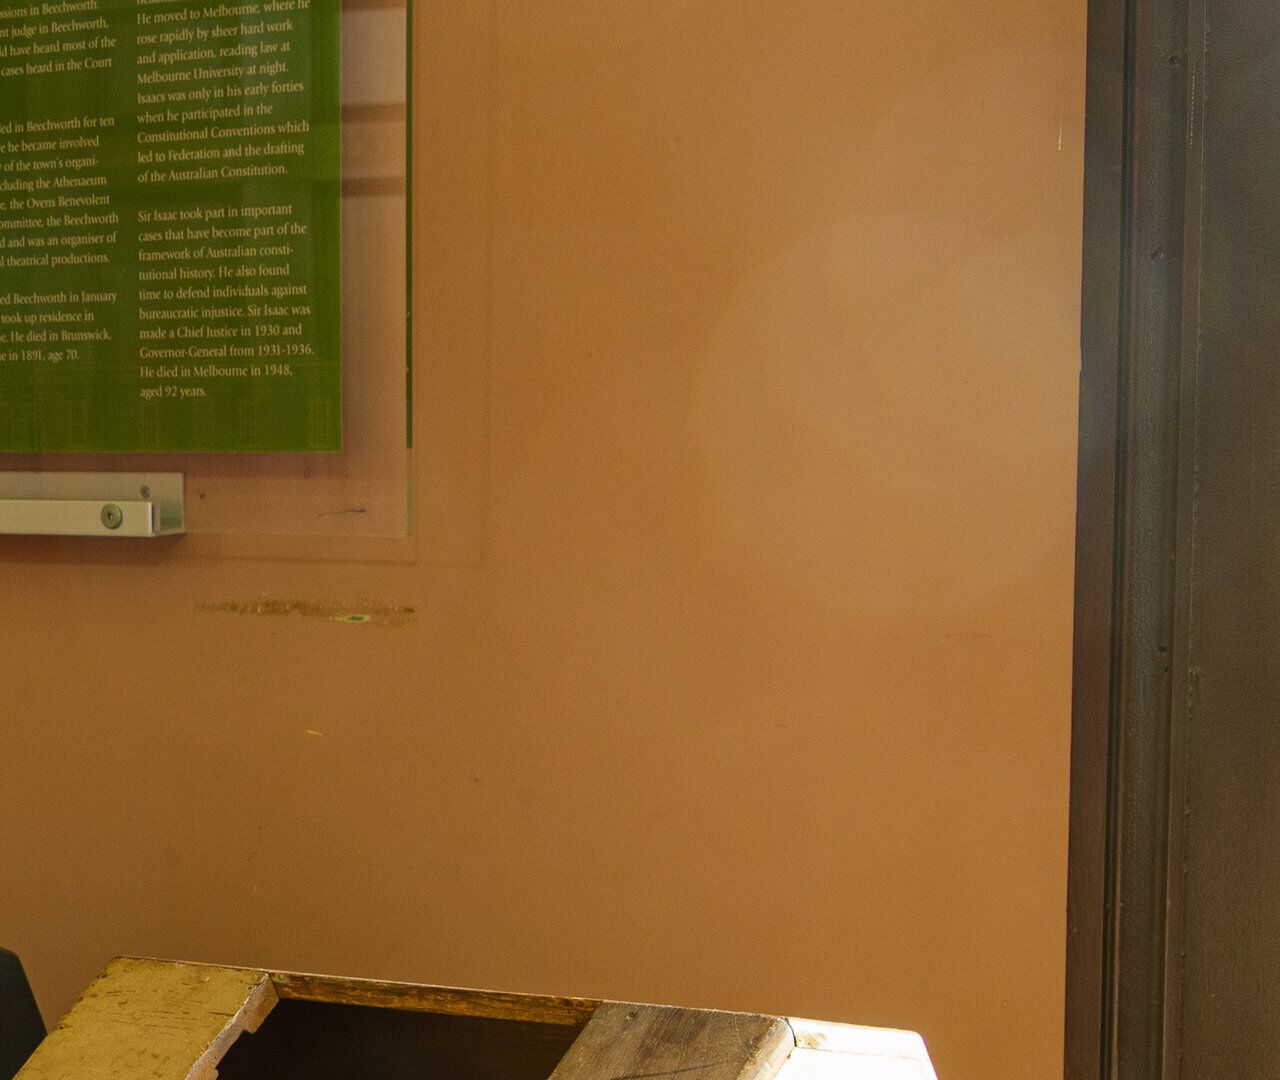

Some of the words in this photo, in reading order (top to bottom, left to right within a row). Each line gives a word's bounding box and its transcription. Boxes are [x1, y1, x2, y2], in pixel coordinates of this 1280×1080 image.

[154, 8, 187, 23] moved
[262, 0, 295, 13] where
[137, 35, 156, 44] rose
[159, 29, 194, 44] rapidly
[211, 25, 237, 38] sheer
[240, 21, 264, 35] hard
[266, 19, 292, 33] work
[137, 70, 190, 84] Melbourne
[193, 66, 244, 81] University
[138, 127, 208, 143] Constitutional
[210, 124, 275, 138] Conventions
[278, 120, 310, 134] which
[150, 170, 166, 182] the
[169, 168, 218, 181] Australian
[9, 198, 24, 210] the
[26, 197, 56, 209] Ovens
[57, 194, 110, 207] Benevolent
[46, 215, 61, 227] the
[63, 212, 118, 226] Beechworth
[138, 210, 150, 222] Sir
[153, 209, 177, 221] Isaac
[180, 207, 202, 220] took
[204, 207, 224, 221] part
[240, 205, 292, 219] important
[138, 233, 162, 242] cases
[164, 228, 184, 241] that
[186, 227, 209, 240] have
[211, 226, 251, 238] become
[253, 225, 273, 239] part
[290, 222, 307, 235] the
[7, 235, 25, 248] and
[27, 238, 44, 247] was
[60, 234, 103, 247] organiser
[6, 253, 48, 267] theatrical
[138, 247, 190, 261] framework
[206, 245, 256, 258] Australian
[139, 268, 176, 281] tutional
[235, 265, 256, 277] also
[258, 263, 289, 276] found
[13, 291, 66, 304] Beechworth
[81, 290, 118, 305] January
[0, 312, 22, 324] took
[38, 310, 82, 323] residence
[139, 307, 198, 320] bureaucratic
[247, 305, 262, 317] Sir
[263, 304, 288, 316] Isaac
[291, 307, 310, 316] was
[26, 329, 46, 342] died
[139, 327, 166, 339] made
[176, 326, 203, 338] Chief
[206, 325, 237, 341] Justice
[255, 324, 279, 336] 1930
[281, 324, 302, 336] and
[47, 352, 63, 363] age
[140, 345, 226, 359] Governor-General
[229, 345, 254, 357] from
[140, 385, 162, 400] aged
